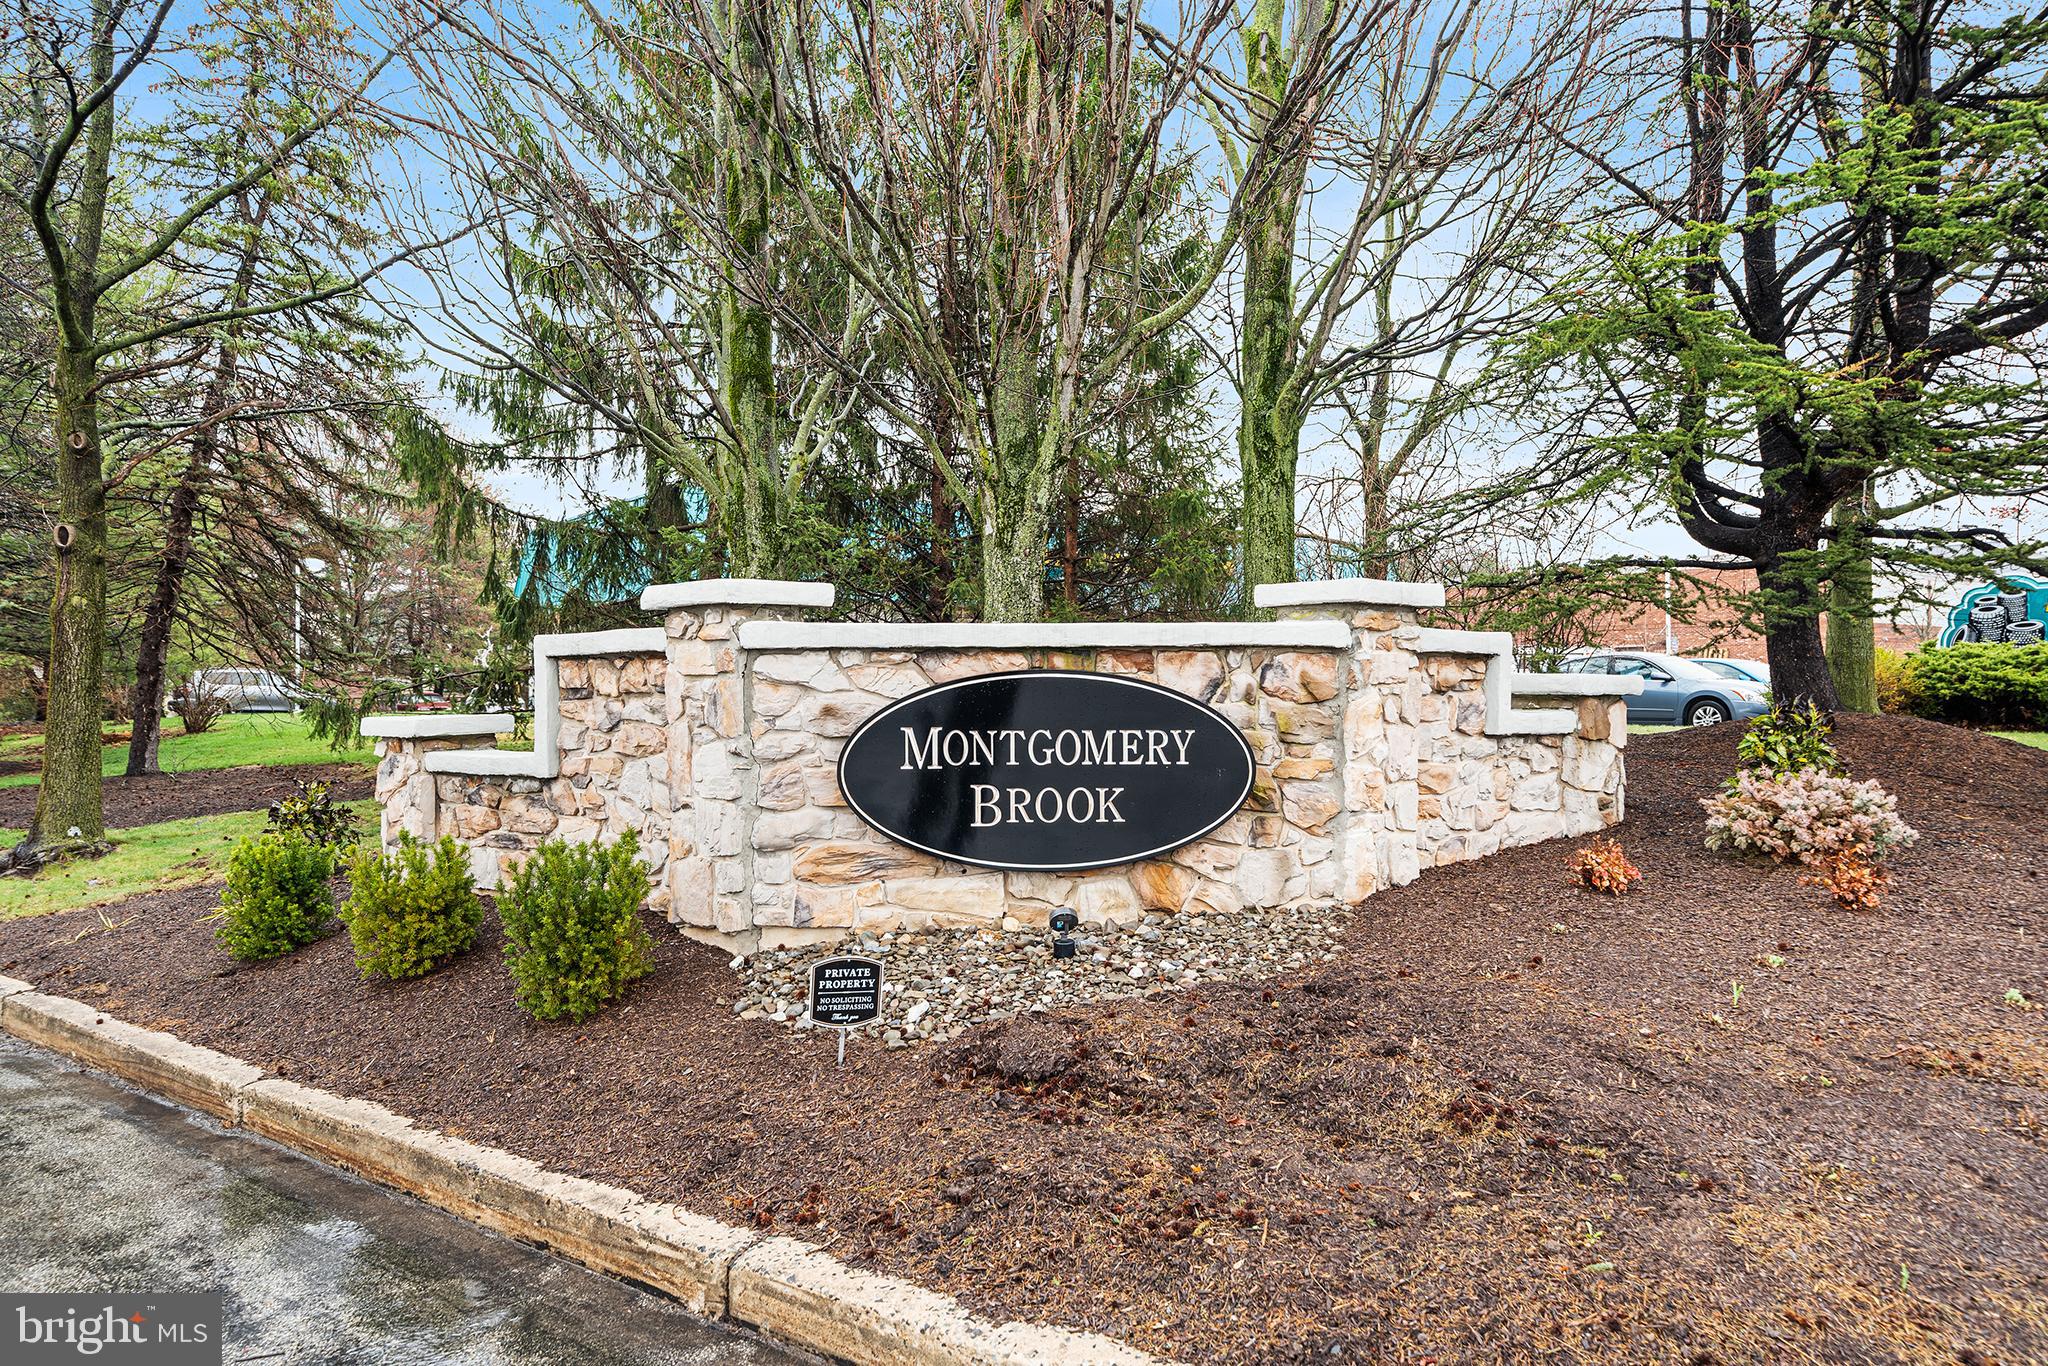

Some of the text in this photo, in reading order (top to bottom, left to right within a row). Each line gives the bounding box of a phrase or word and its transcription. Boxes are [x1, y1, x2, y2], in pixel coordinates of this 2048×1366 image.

[900, 726, 1195, 770] MONTGOMERY
[970, 784, 1125, 827] BROOK
[825, 968, 871, 978] PRIVATE
[819, 979, 875, 989] PROPERTY
[829, 1003, 874, 1011] TRESPASSING
